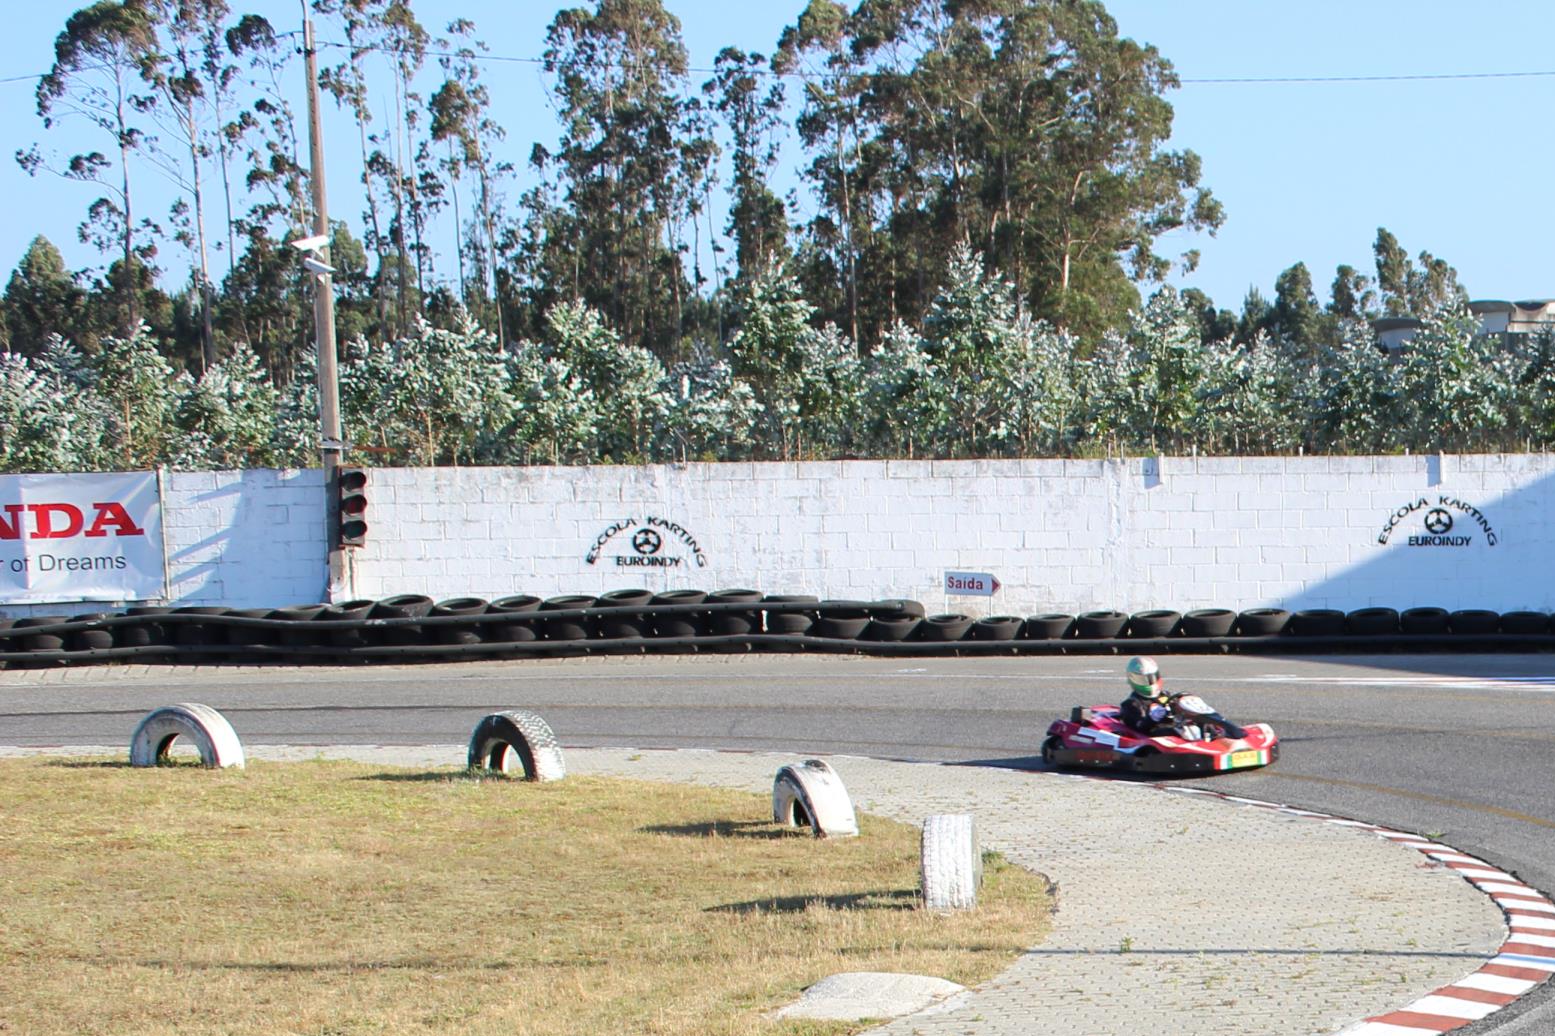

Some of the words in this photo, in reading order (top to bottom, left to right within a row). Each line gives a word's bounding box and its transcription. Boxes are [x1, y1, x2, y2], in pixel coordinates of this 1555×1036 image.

[1378, 497, 1429, 545] ESCOLA
[1439, 495, 1498, 546] KARTING
[586, 517, 637, 565] ESCOLA
[647, 515, 708, 567] KARTING
[1408, 535, 1472, 546] EUROINDY
[10, 555, 30, 573] of
[38, 553, 127, 571] Dreams
[616, 555, 681, 567] EUROINDY
[947, 575, 984, 590] Saída
